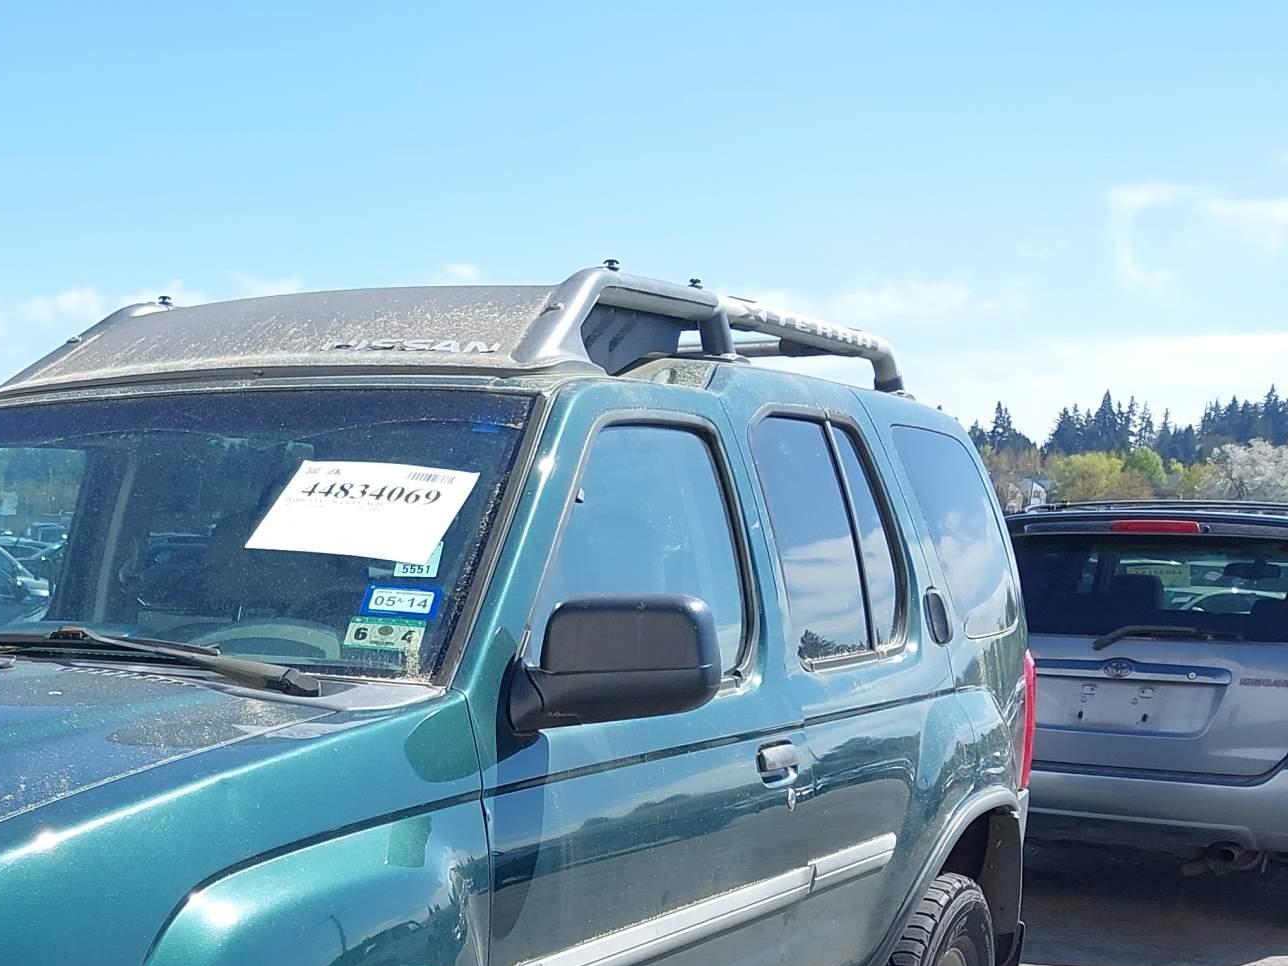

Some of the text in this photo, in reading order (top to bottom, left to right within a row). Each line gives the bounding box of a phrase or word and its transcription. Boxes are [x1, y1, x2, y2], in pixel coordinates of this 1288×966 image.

[320, 339, 500, 353] NISSAN
[301, 481, 442, 506] 44834069
[402, 564, 431, 575] 5551
[374, 595, 429, 609] 05 14
